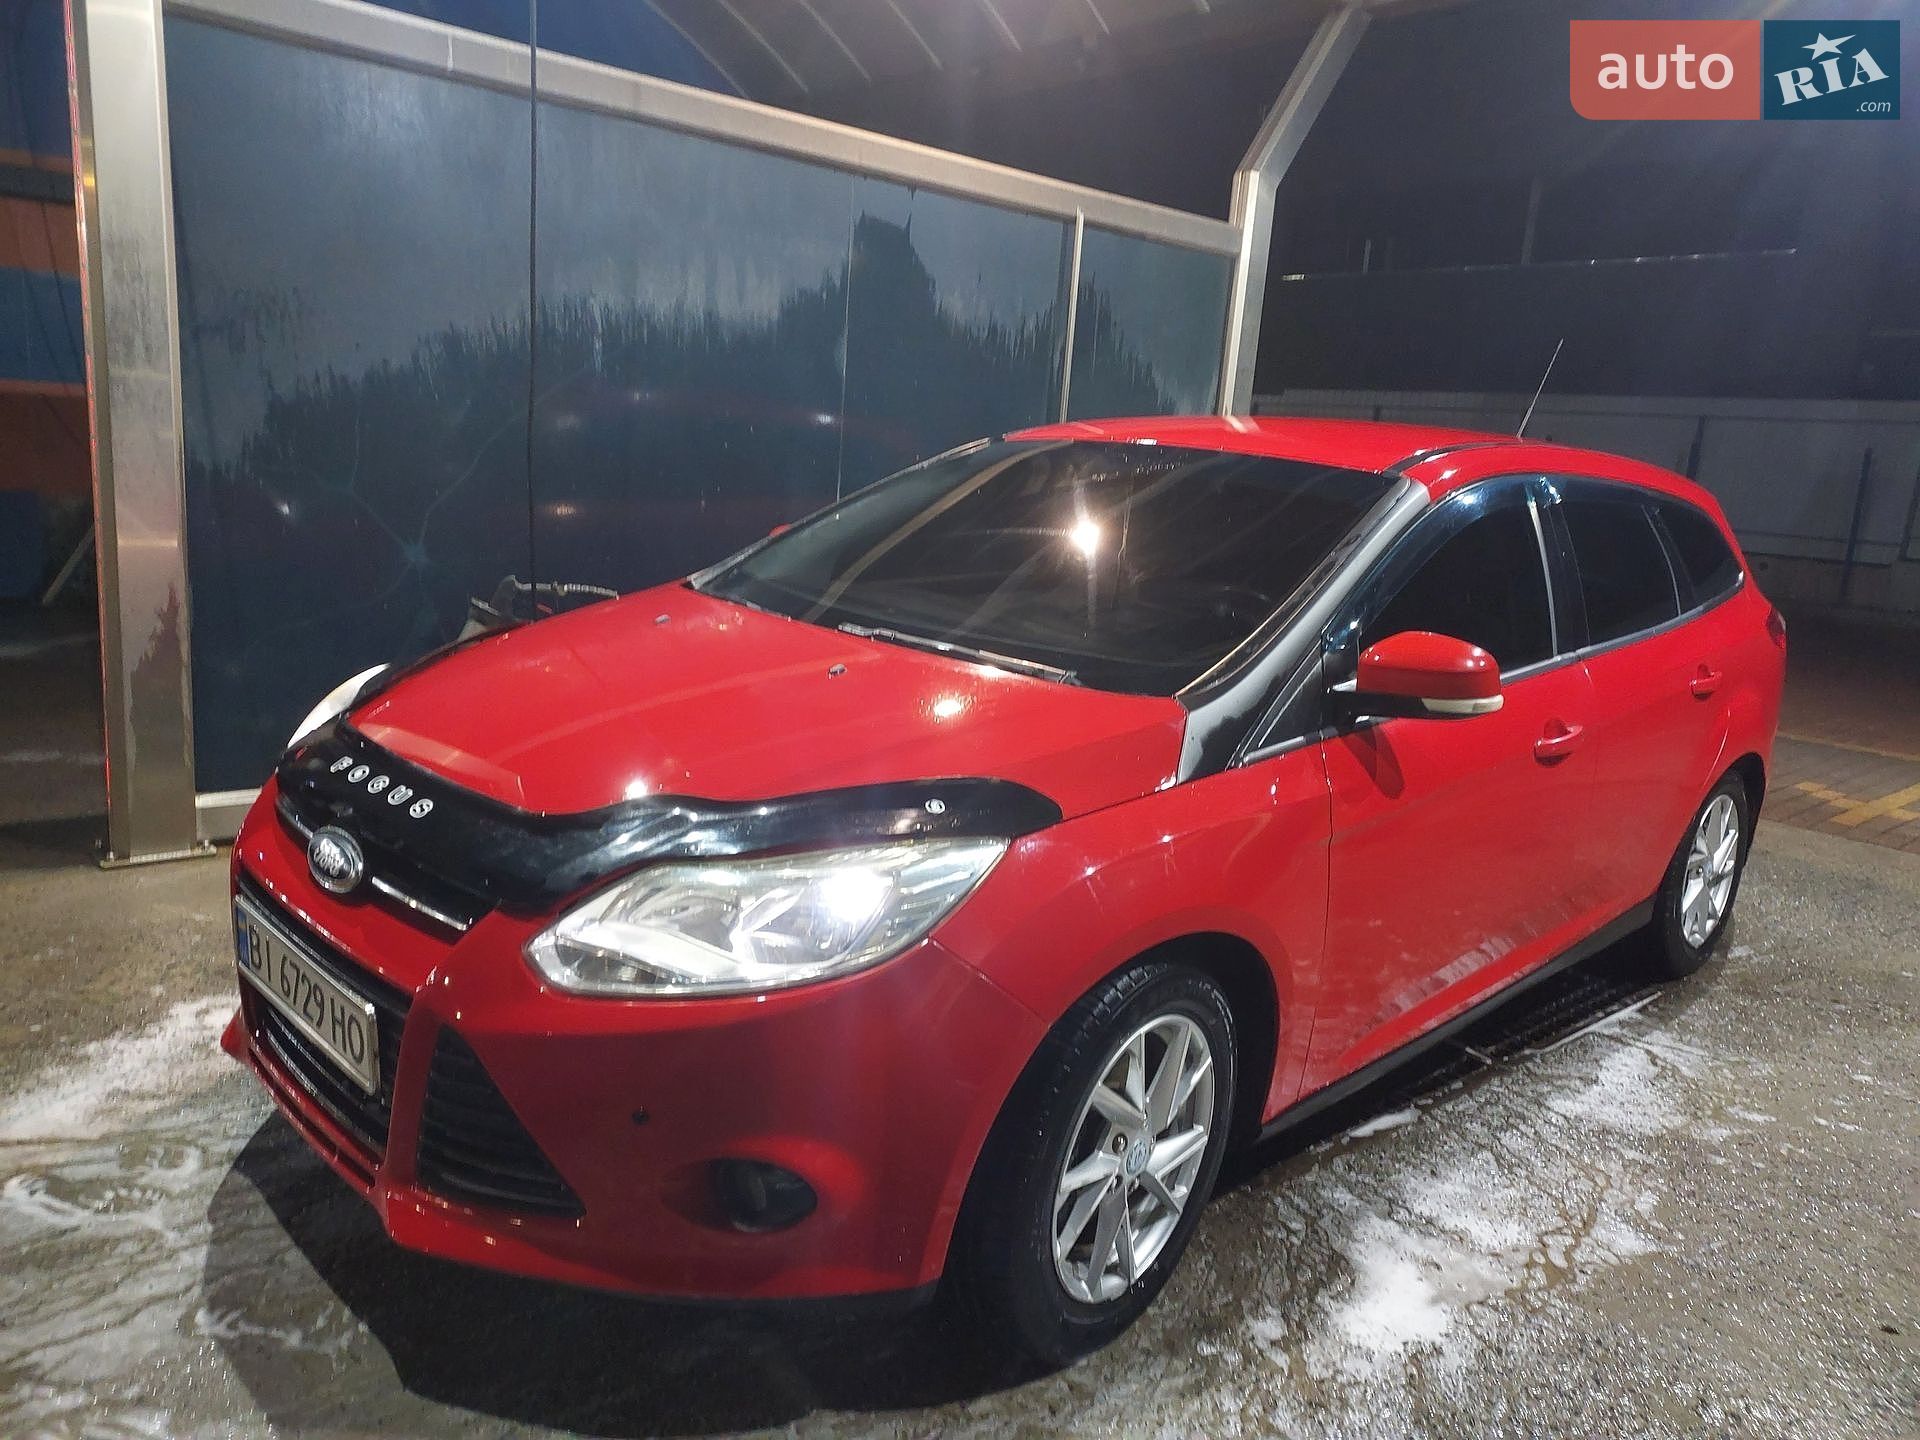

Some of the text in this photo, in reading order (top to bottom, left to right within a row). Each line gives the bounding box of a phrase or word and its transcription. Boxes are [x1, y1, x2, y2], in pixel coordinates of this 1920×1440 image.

[330, 756, 434, 819] FOCUS
[280, 955, 325, 1028] 6729
[330, 997, 365, 1065] HO
